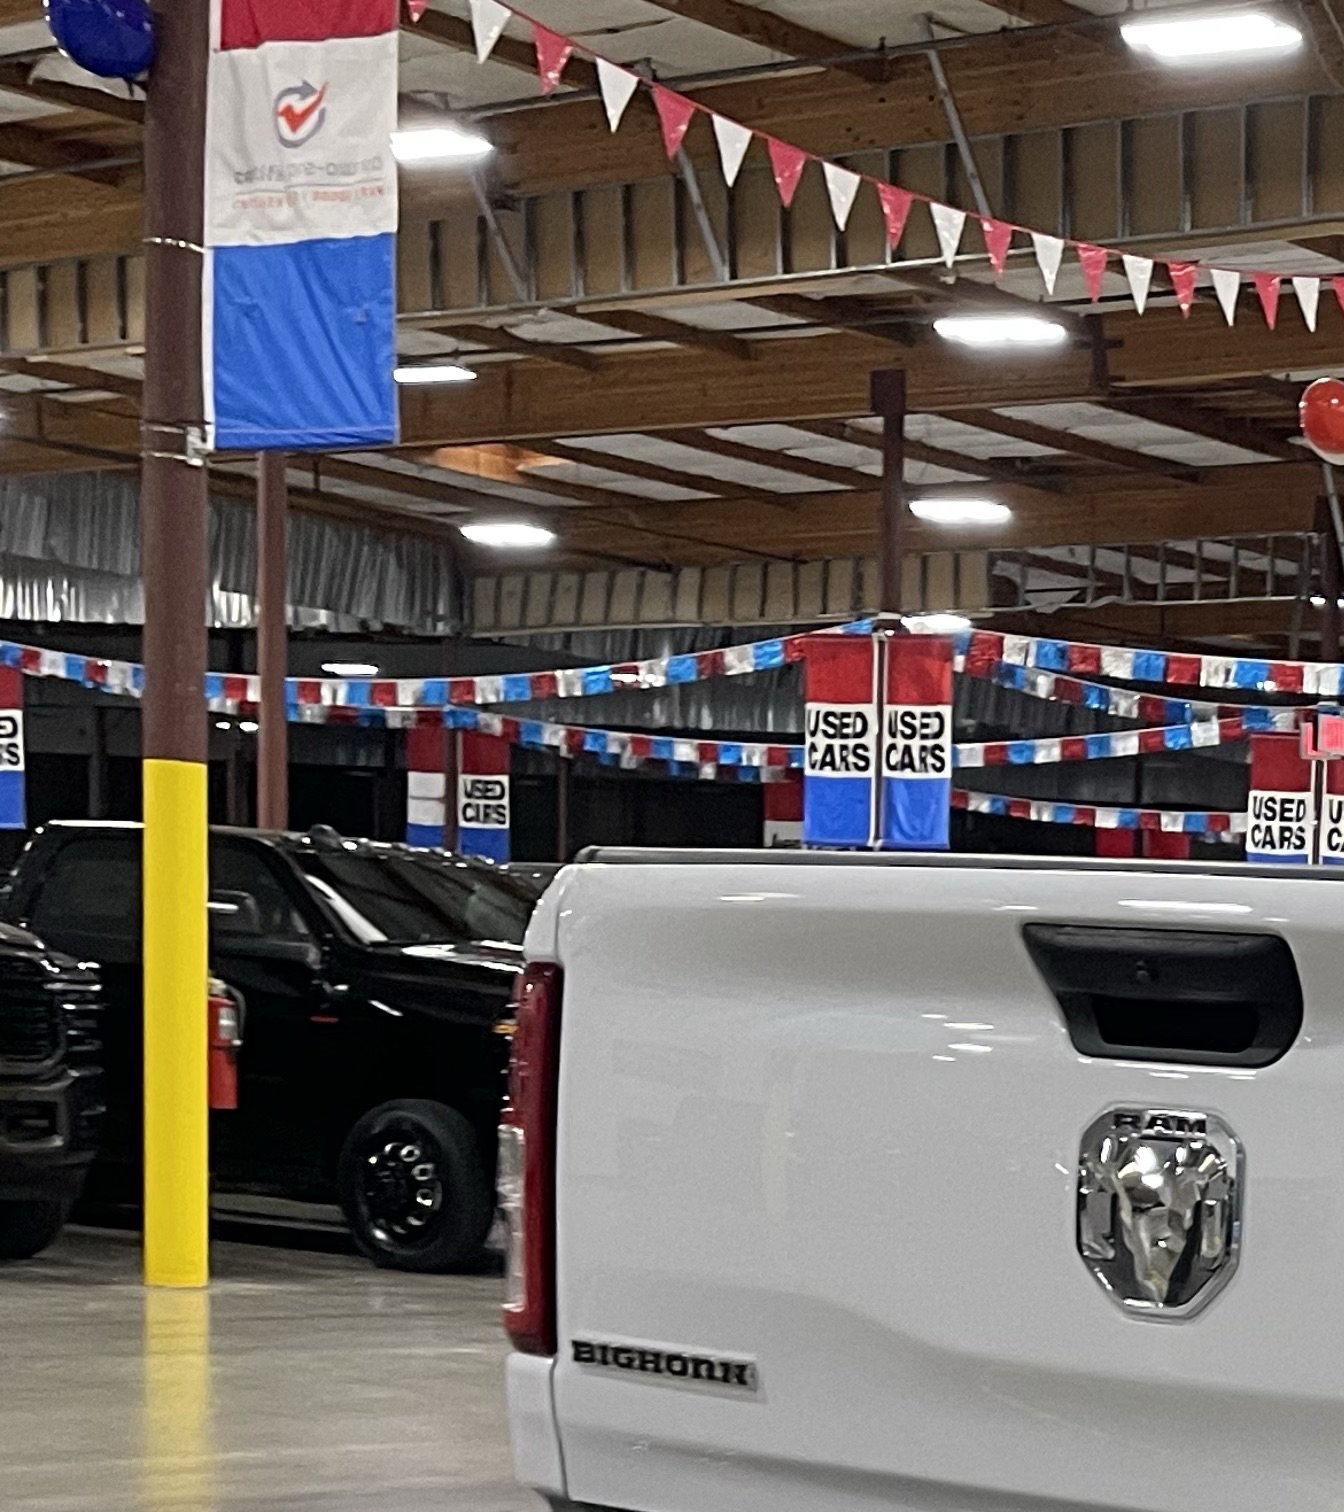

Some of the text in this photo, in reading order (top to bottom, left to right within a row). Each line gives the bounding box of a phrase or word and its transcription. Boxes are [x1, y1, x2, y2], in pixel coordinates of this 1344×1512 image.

[808, 710, 868, 739] USED
[888, 711, 945, 740] USED
[808, 743, 870, 771] CARS
[886, 743, 945, 773] CARS
[1253, 796, 1306, 822] USED
[1251, 824, 1306, 849] CARS
[1113, 1113, 1206, 1136] RAM
[571, 1339, 750, 1386] BIGHORN
